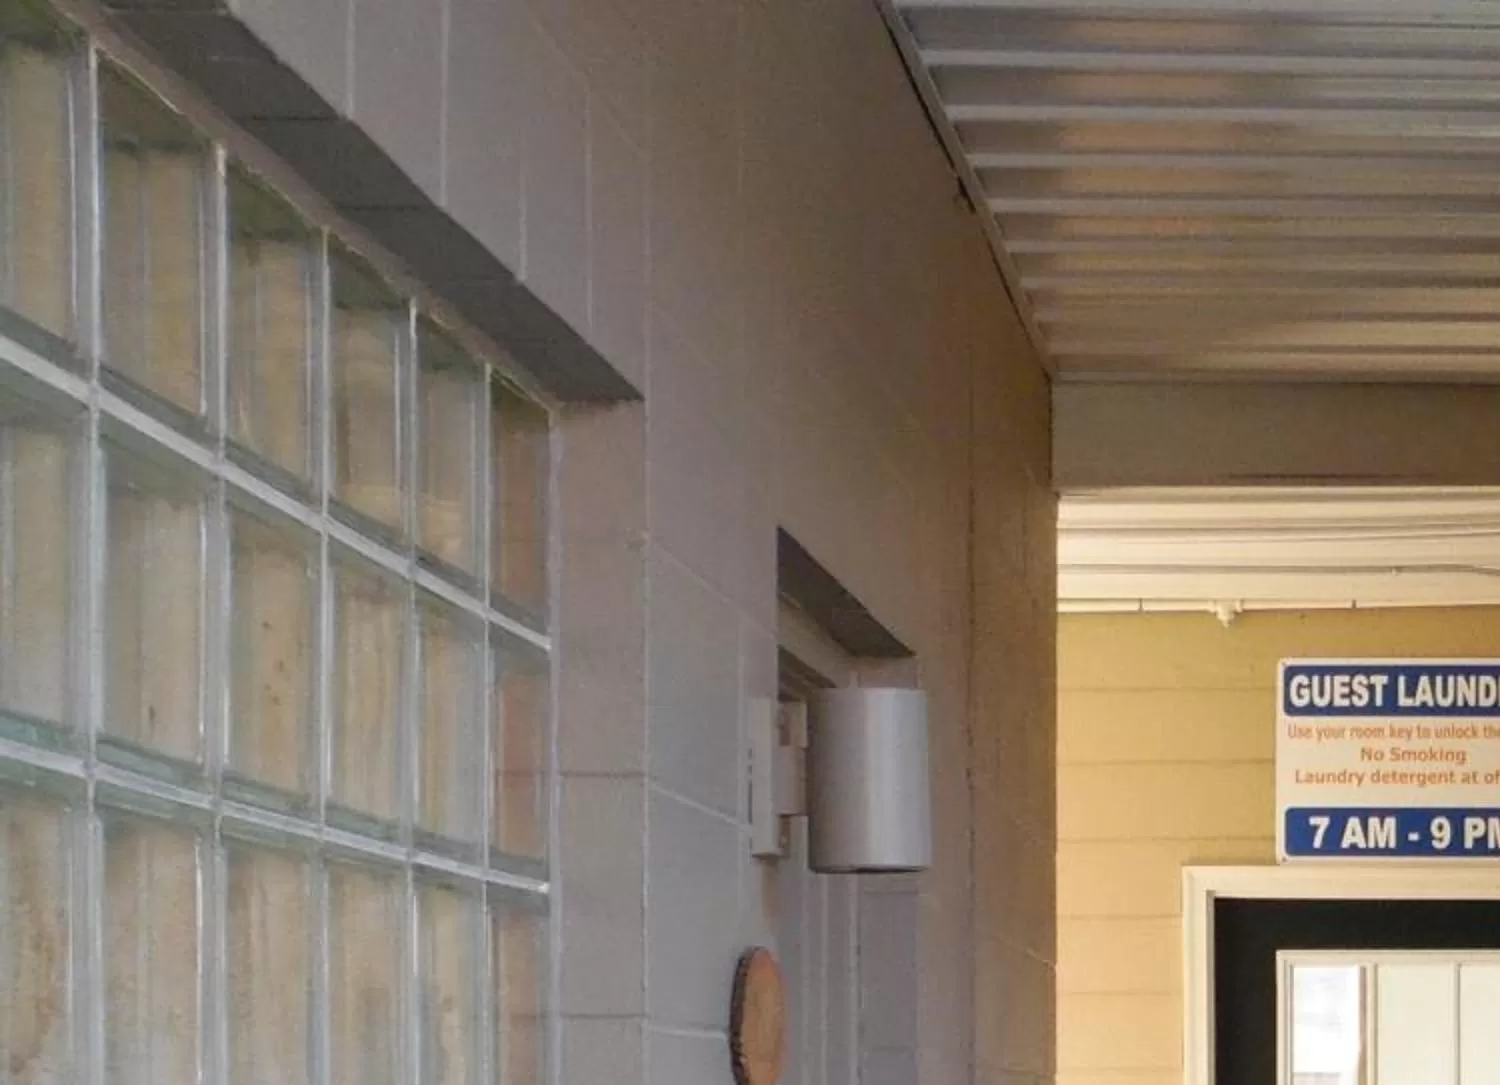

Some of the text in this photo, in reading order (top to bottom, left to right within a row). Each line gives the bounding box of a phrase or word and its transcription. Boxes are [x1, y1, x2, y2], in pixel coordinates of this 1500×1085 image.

[1290, 674, 1388, 707] GUEST
[1288, 724, 1312, 738] Use
[1316, 727, 1346, 742] your
[1350, 727, 1384, 738] room
[1389, 724, 1413, 742] key
[1416, 725, 1431, 738] to
[1434, 724, 1477, 738] unlock
[1360, 748, 1467, 765] No Smoking
[1296, 770, 1364, 787] Laundry
[1371, 770, 1454, 787] detergent
[1461, 771, 1478, 784] at
[1309, 817, 1330, 849] 7
[1341, 817, 1396, 849] AM
[1430, 817, 1451, 849] 9
